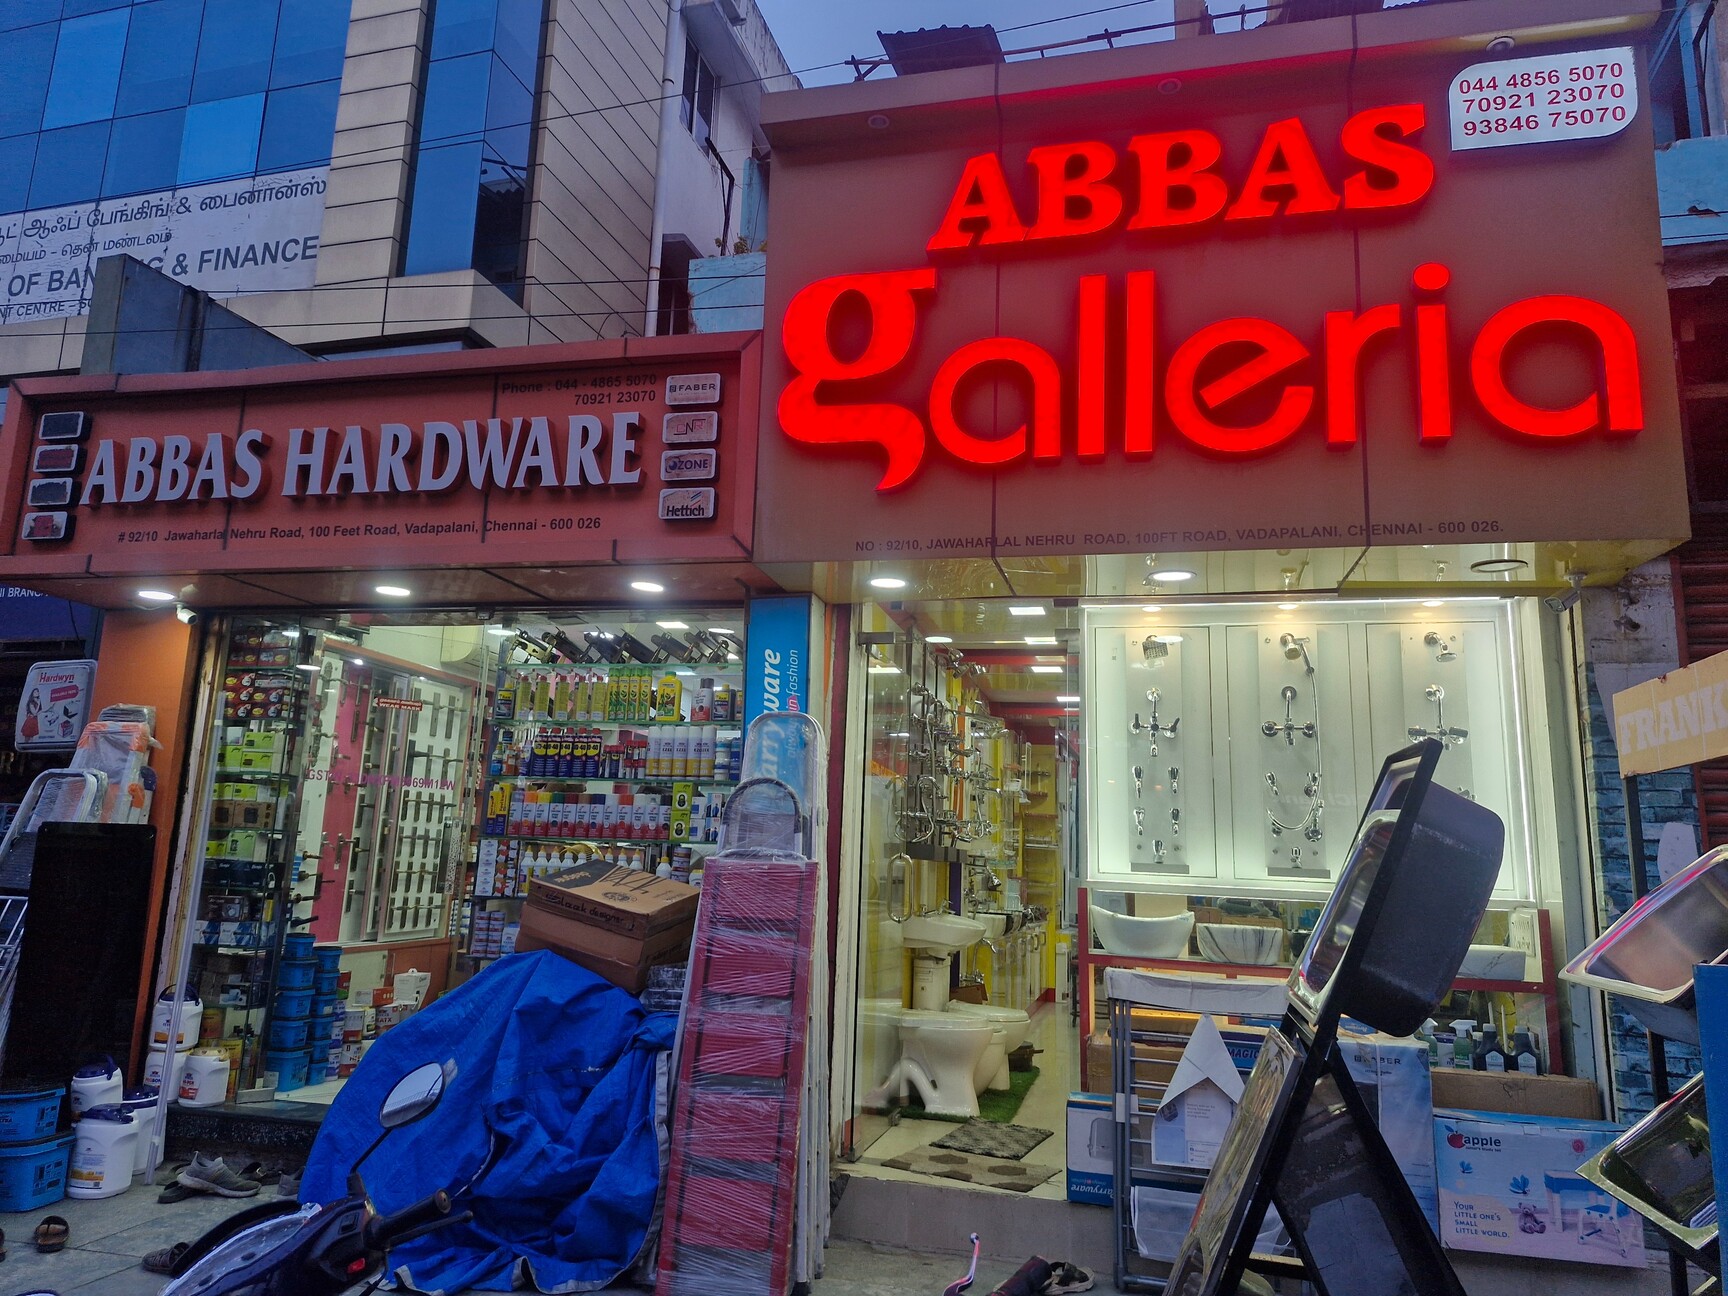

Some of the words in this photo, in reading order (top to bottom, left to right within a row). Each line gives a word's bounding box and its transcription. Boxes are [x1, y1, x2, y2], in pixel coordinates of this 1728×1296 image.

[1459, 76, 1498, 94] 044
[1506, 69, 1560, 88] 4856
[1568, 62, 1623, 82] 5070
[1462, 92, 1535, 114] 70921
[1547, 83, 1625, 105] 23070
[1463, 115, 1540, 136] 93846
[1548, 106, 1626, 128] 75070
[926, 102, 1436, 253] ABBAS
[176, 196, 191, 214] &
[200, 176, 327, 211] பைனான்ஸ்
[8, 272, 41, 297] OF
[171, 253, 188, 276] &
[198, 235, 319, 273] FINANCE
[16, 301, 65, 317] CENTRE
[502, 380, 543, 394] Phone
[556, 378, 578, 391] 044
[591, 376, 621, 389] 4865
[625, 374, 657, 387] 5070
[776, 261, 1646, 493] galleria
[575, 392, 612, 406] 70921
[617, 390, 656, 404] 23070
[678, 383, 716, 393] FABER
[80, 429, 266, 506] ABBAS
[281, 411, 643, 497] HARDWARE
[666, 504, 705, 517] Hettich
[118, 532, 126, 543] #
[128, 531, 158, 543] 92/10
[230, 528, 265, 539] Nehru
[270, 527, 305, 539] Road,
[309, 526, 330, 537] 100
[334, 525, 360, 536] Feet
[364, 524, 400, 536] Road,
[405, 521, 478, 536] Vadapalani,
[484, 519, 537, 531] Chennai
[550, 518, 573, 530] 600
[577, 517, 601, 529] 026
[855, 541, 875, 551] NO
[886, 539, 923, 551] 92/10,
[927, 536, 1021, 549] JAWAHARLAL
[1026, 534, 1075, 546] NEHRU
[1084, 532, 1130, 545] ROAD,
[1136, 531, 1178, 544] 100FT
[1183, 529, 1231, 542] ROAD,
[1236, 526, 1342, 541] VADAPALANI,
[1347, 523, 1423, 536] CHENNAI
[1438, 521, 1466, 534] 600
[1471, 520, 1504, 533] 026.
[40, 672, 75, 683] Hardwyn
[786, 650, 801, 697] fashion
[786, 699, 798, 712] in
[1464, 1135, 1502, 1148] apple
[1454, 1201, 1474, 1211] YOUR
[1454, 1212, 1477, 1220] LITTLE
[1479, 1212, 1501, 1221] ONE'S
[1455, 1219, 1478, 1228] SMALL
[1455, 1227, 1478, 1235] LITTLE
[1481, 1229, 1510, 1239] WORLD.
